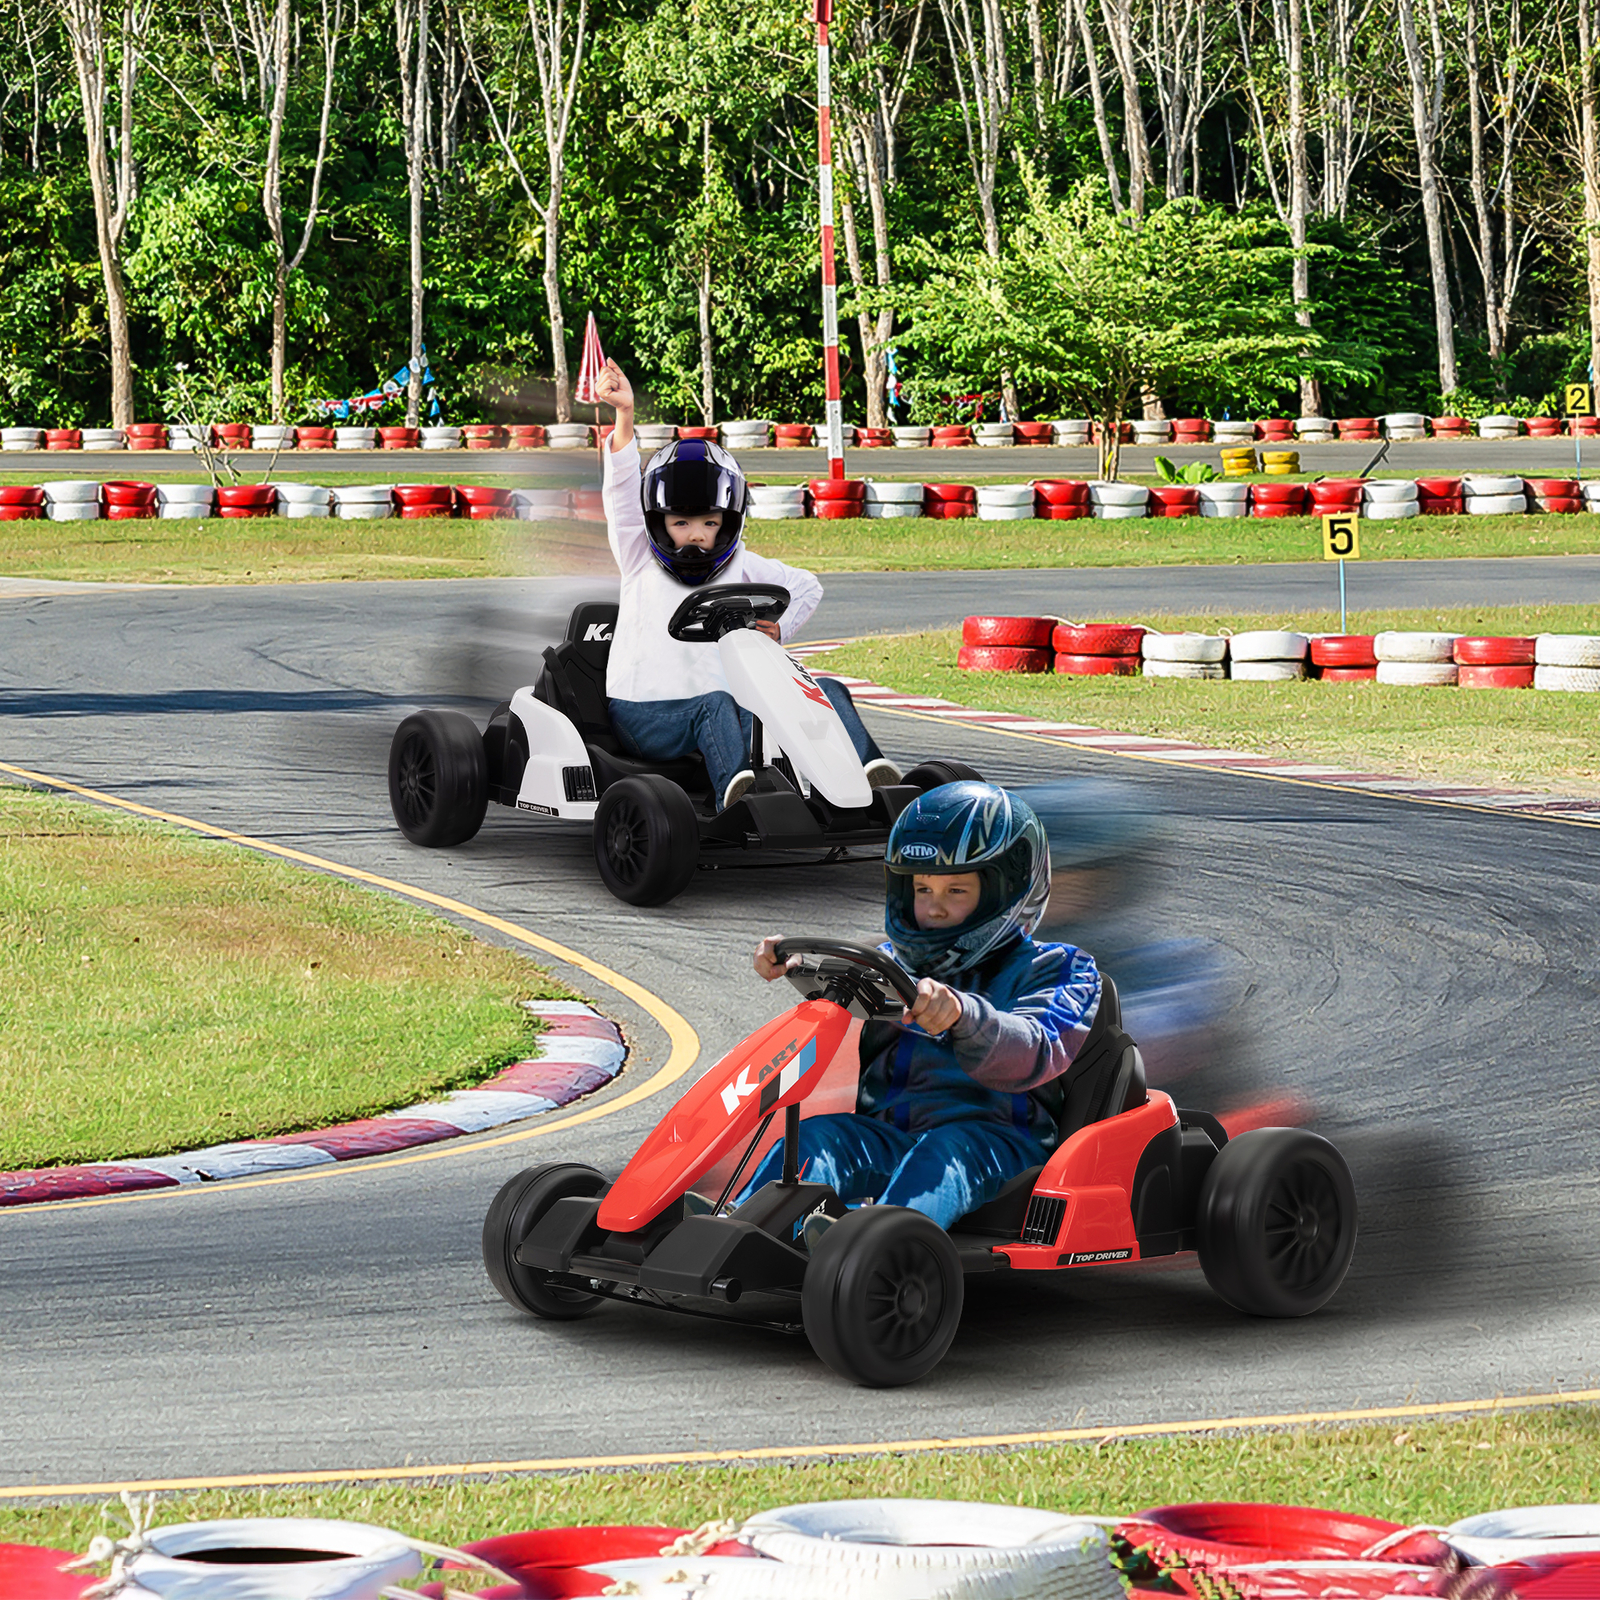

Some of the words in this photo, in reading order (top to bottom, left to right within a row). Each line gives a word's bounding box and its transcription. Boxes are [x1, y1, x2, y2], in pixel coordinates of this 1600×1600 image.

[1570, 387, 1586, 410] 2
[1329, 518, 1354, 555] 5
[582, 623, 613, 642] KA
[519, 802, 530, 810] TOP
[530, 804, 550, 814] DRIVER
[720, 1038, 798, 1116] KART
[792, 1198, 827, 1241] KRT
[1075, 1253, 1095, 1263] TOP
[1095, 1250, 1129, 1261] DRIVER
